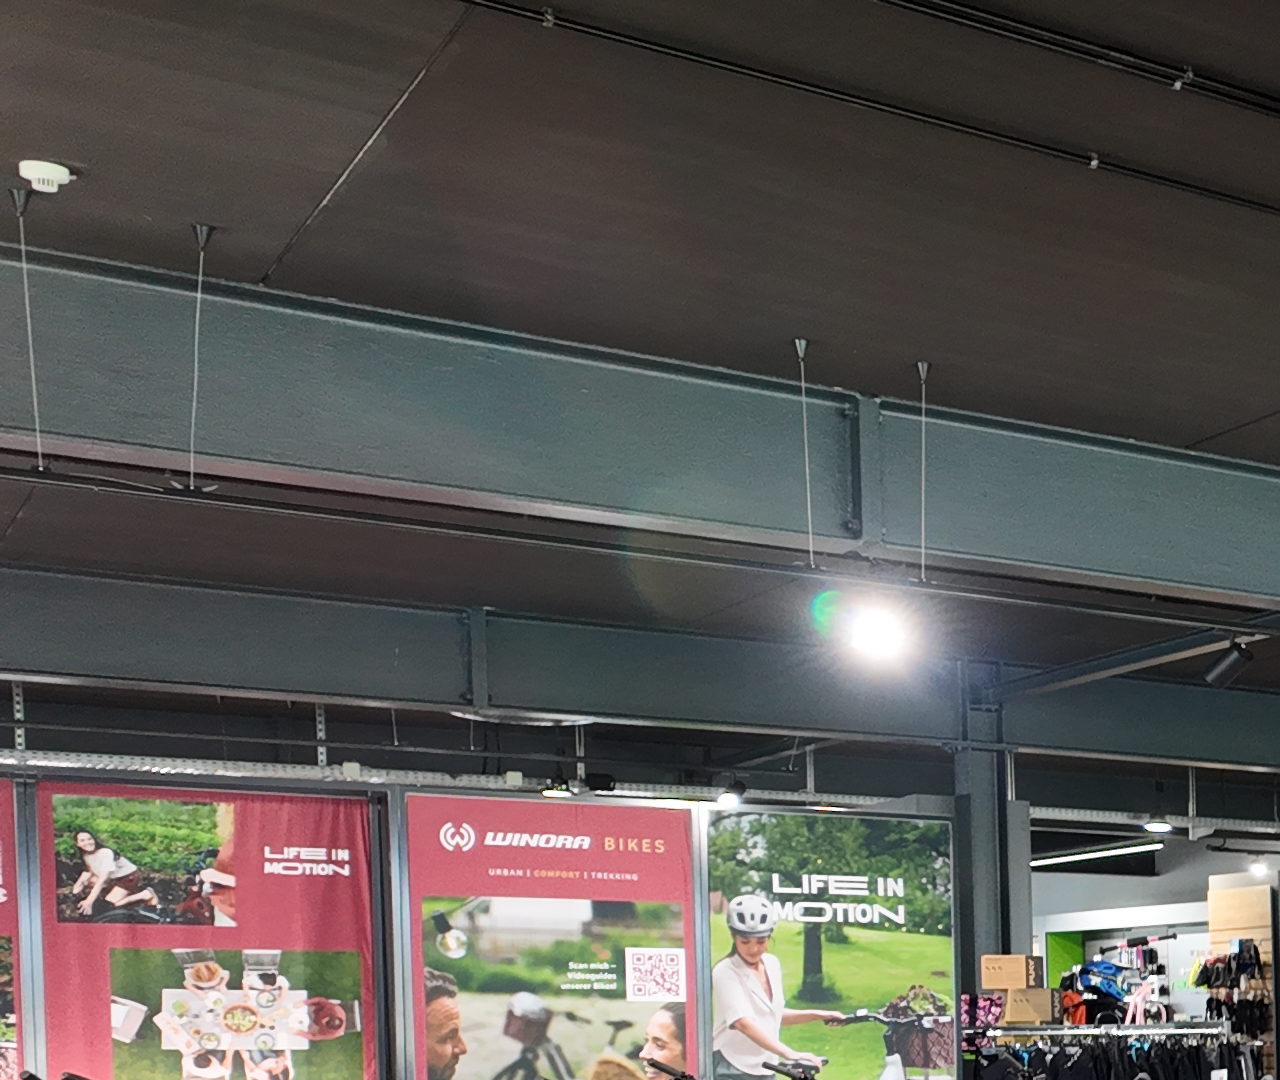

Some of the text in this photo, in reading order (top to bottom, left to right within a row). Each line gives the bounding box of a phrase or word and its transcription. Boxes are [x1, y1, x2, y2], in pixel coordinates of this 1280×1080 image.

[484, 832, 591, 850] WINORA
[604, 837, 665, 853] BIKES
[264, 846, 349, 861] LIFE IN
[264, 862, 350, 876] MOTION
[488, 868, 523, 877] URBAN
[533, 870, 580, 878] COMFORT
[591, 871, 639, 881] TREKKING
[772, 873, 904, 897] LIFE IN
[772, 901, 905, 924] MOTION
